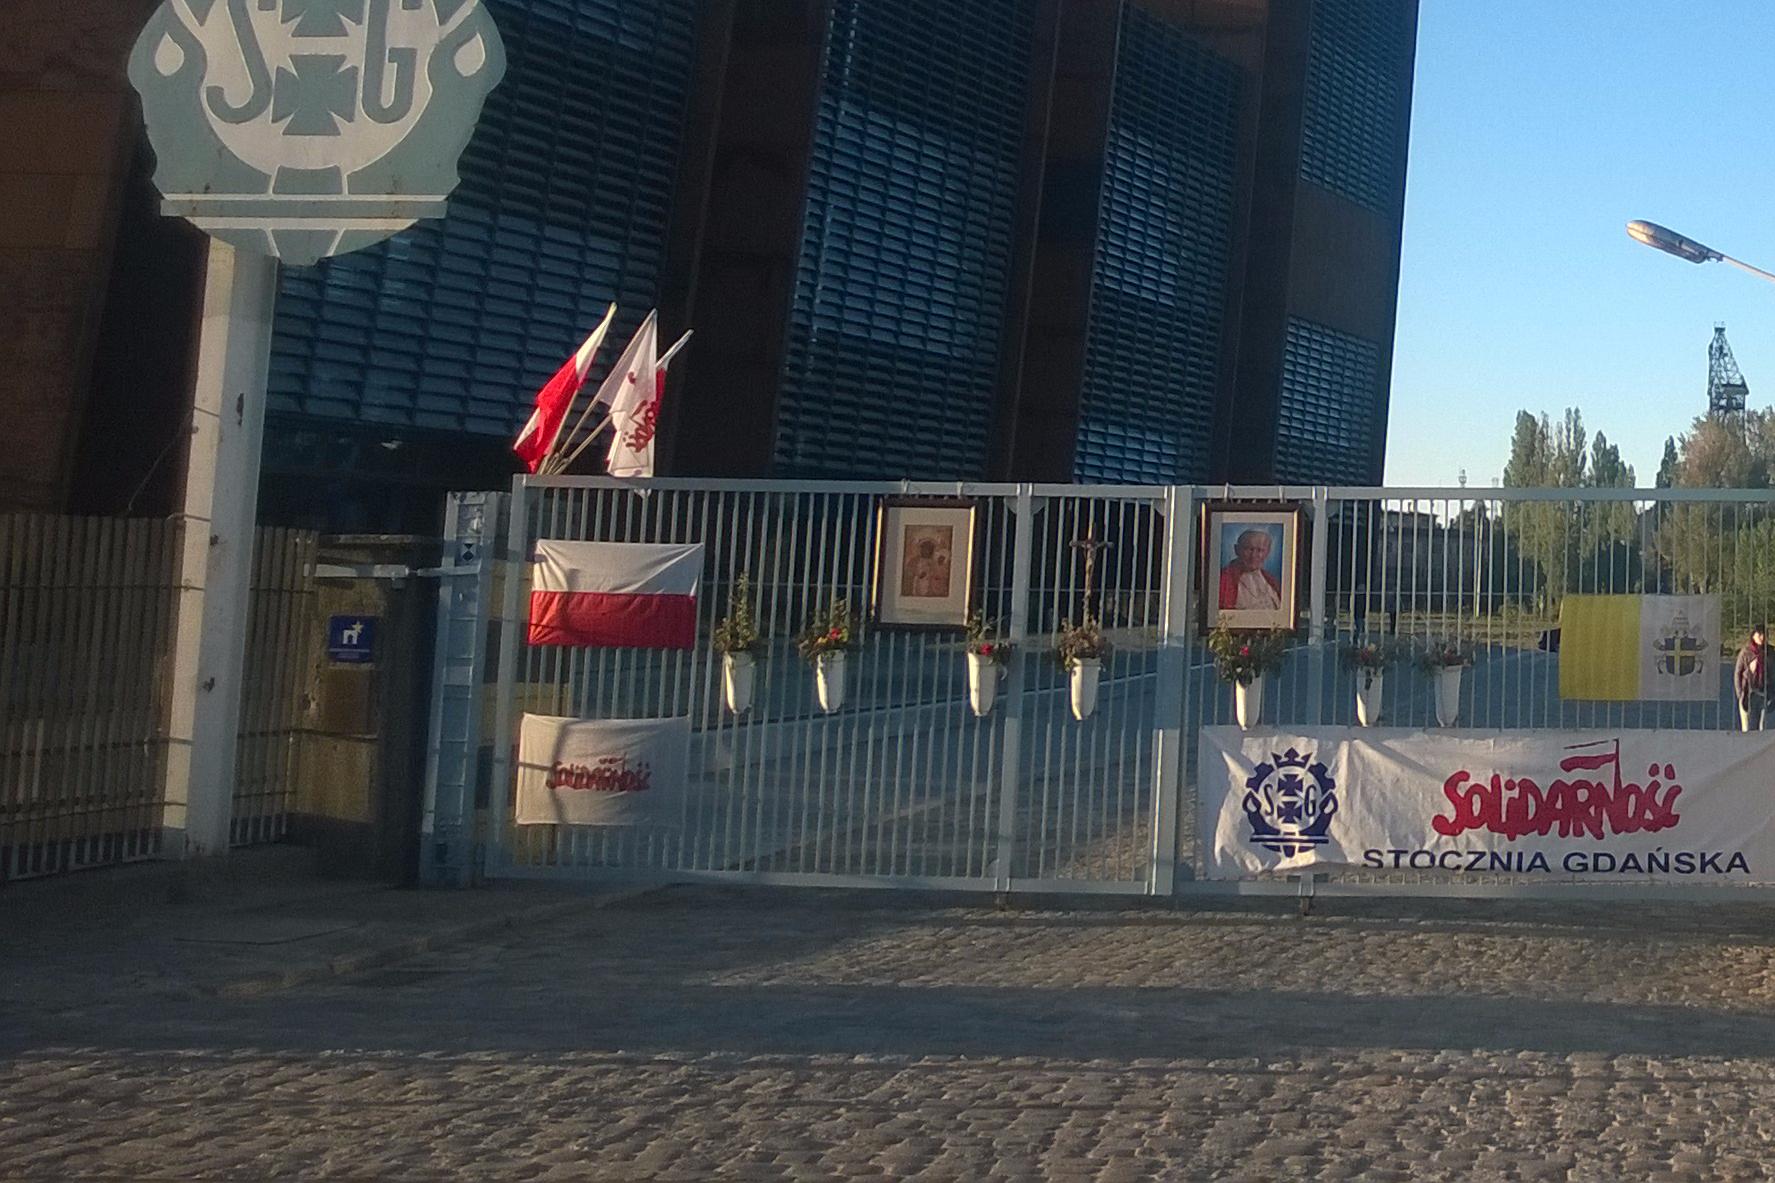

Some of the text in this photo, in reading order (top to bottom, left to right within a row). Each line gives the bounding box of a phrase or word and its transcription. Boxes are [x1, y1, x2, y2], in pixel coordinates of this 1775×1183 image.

[206, 0, 421, 123] S G
[1264, 783, 1317, 817] S G
[1363, 846, 1752, 874] STOCZNIA GDAŃSKA
